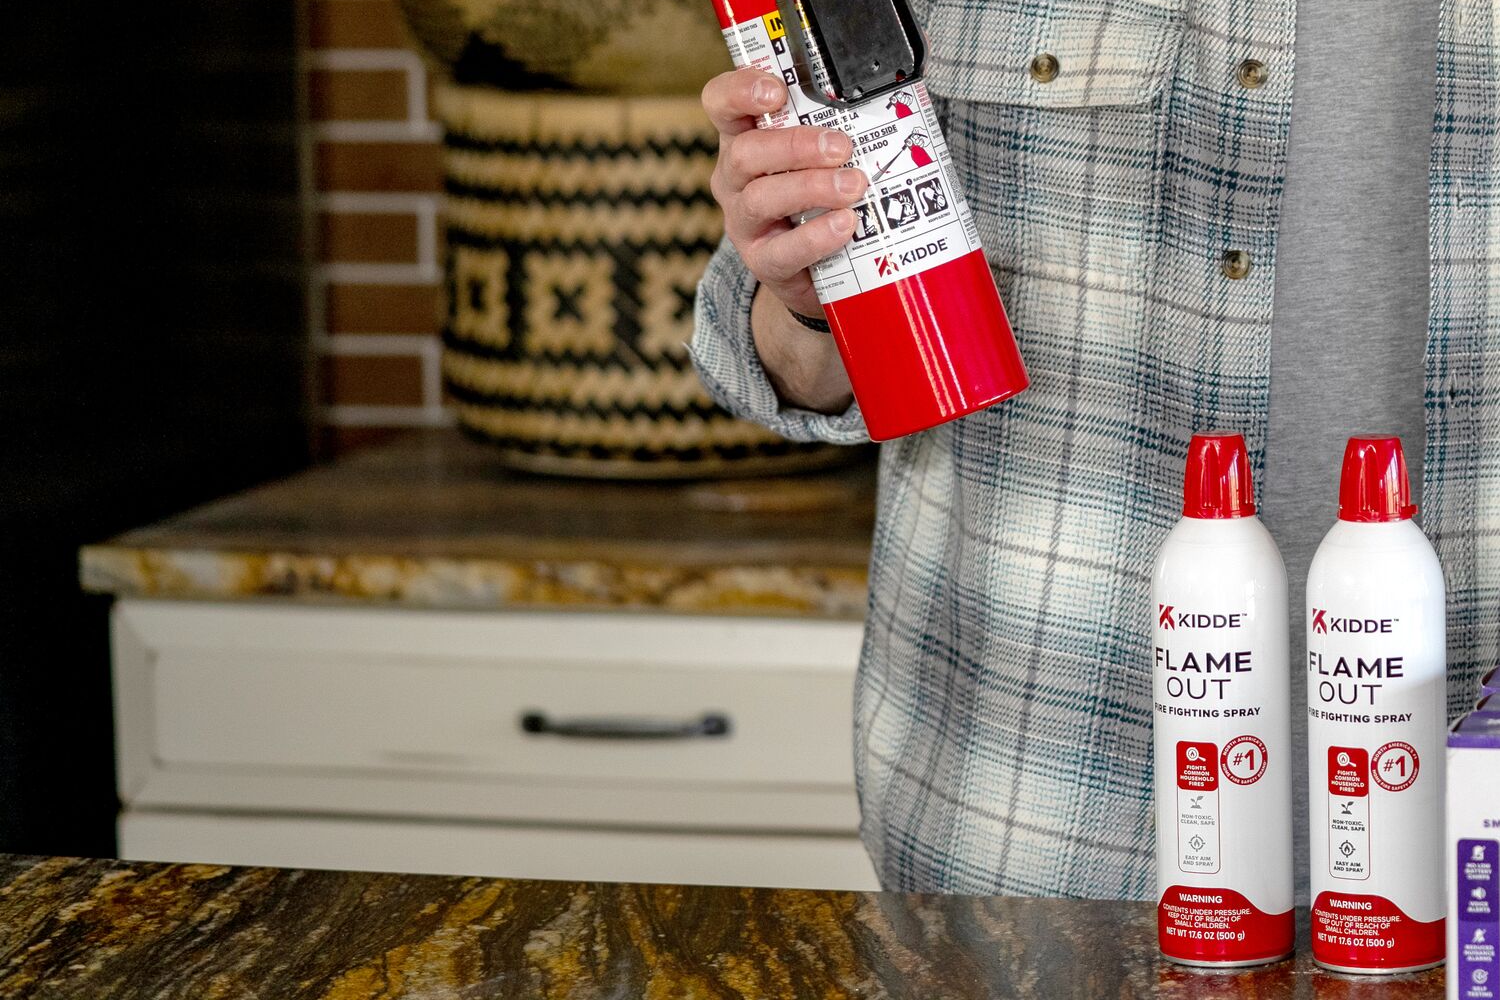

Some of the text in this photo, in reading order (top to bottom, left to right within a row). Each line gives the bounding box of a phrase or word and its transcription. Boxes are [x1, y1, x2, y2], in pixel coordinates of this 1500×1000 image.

[775, 41, 782, 52] 1
[785, 72, 794, 83] 2
[870, 131, 880, 139] TO
[881, 124, 897, 135] SIDE
[868, 140, 888, 152] LADO
[899, 239, 947, 265] KIDDE
[1178, 613, 1241, 628] KIDDE
[1330, 617, 1393, 633] KIDDE
[1155, 646, 1252, 673] FLAME
[1309, 650, 1403, 678] FLAME
[1166, 676, 1231, 700] OUT
[1319, 681, 1382, 705] OUT
[1154, 702, 1261, 718] FIRE FIGHTING SPRAY
[1308, 706, 1412, 723] FIRE FIGHTING SPRAY
[1222, 740, 1237, 756] NORTH
[1373, 746, 1388, 762] NORTH
[1232, 749, 1255, 770] #1
[1383, 755, 1405, 777] #1
[1331, 780, 1365, 788] HOUSEHOLD
[1179, 893, 1223, 904] WARNING
[1329, 899, 1373, 911] WARNING
[1162, 903, 1252, 916] CONTENTS UNDER PRESSURE.
[1167, 911, 1180, 919] KEEP
[1180, 913, 1193, 921] OUT
[1314, 908, 1402, 923] CONTENTS UNDER PRESSURE.
[1174, 919, 1231, 929] SMALL CHILDREN.
[1318, 917, 1331, 925] KEEP
[1330, 919, 1343, 927] OUT
[1380, 922, 1391, 930] OF
[1325, 925, 1380, 936] SMALL CHILDREN.
[1166, 926, 1246, 942] NET WT 17.6 OZ (500 g)
[1317, 932, 1395, 949] NET WT 17.6 OZ (500 g)
